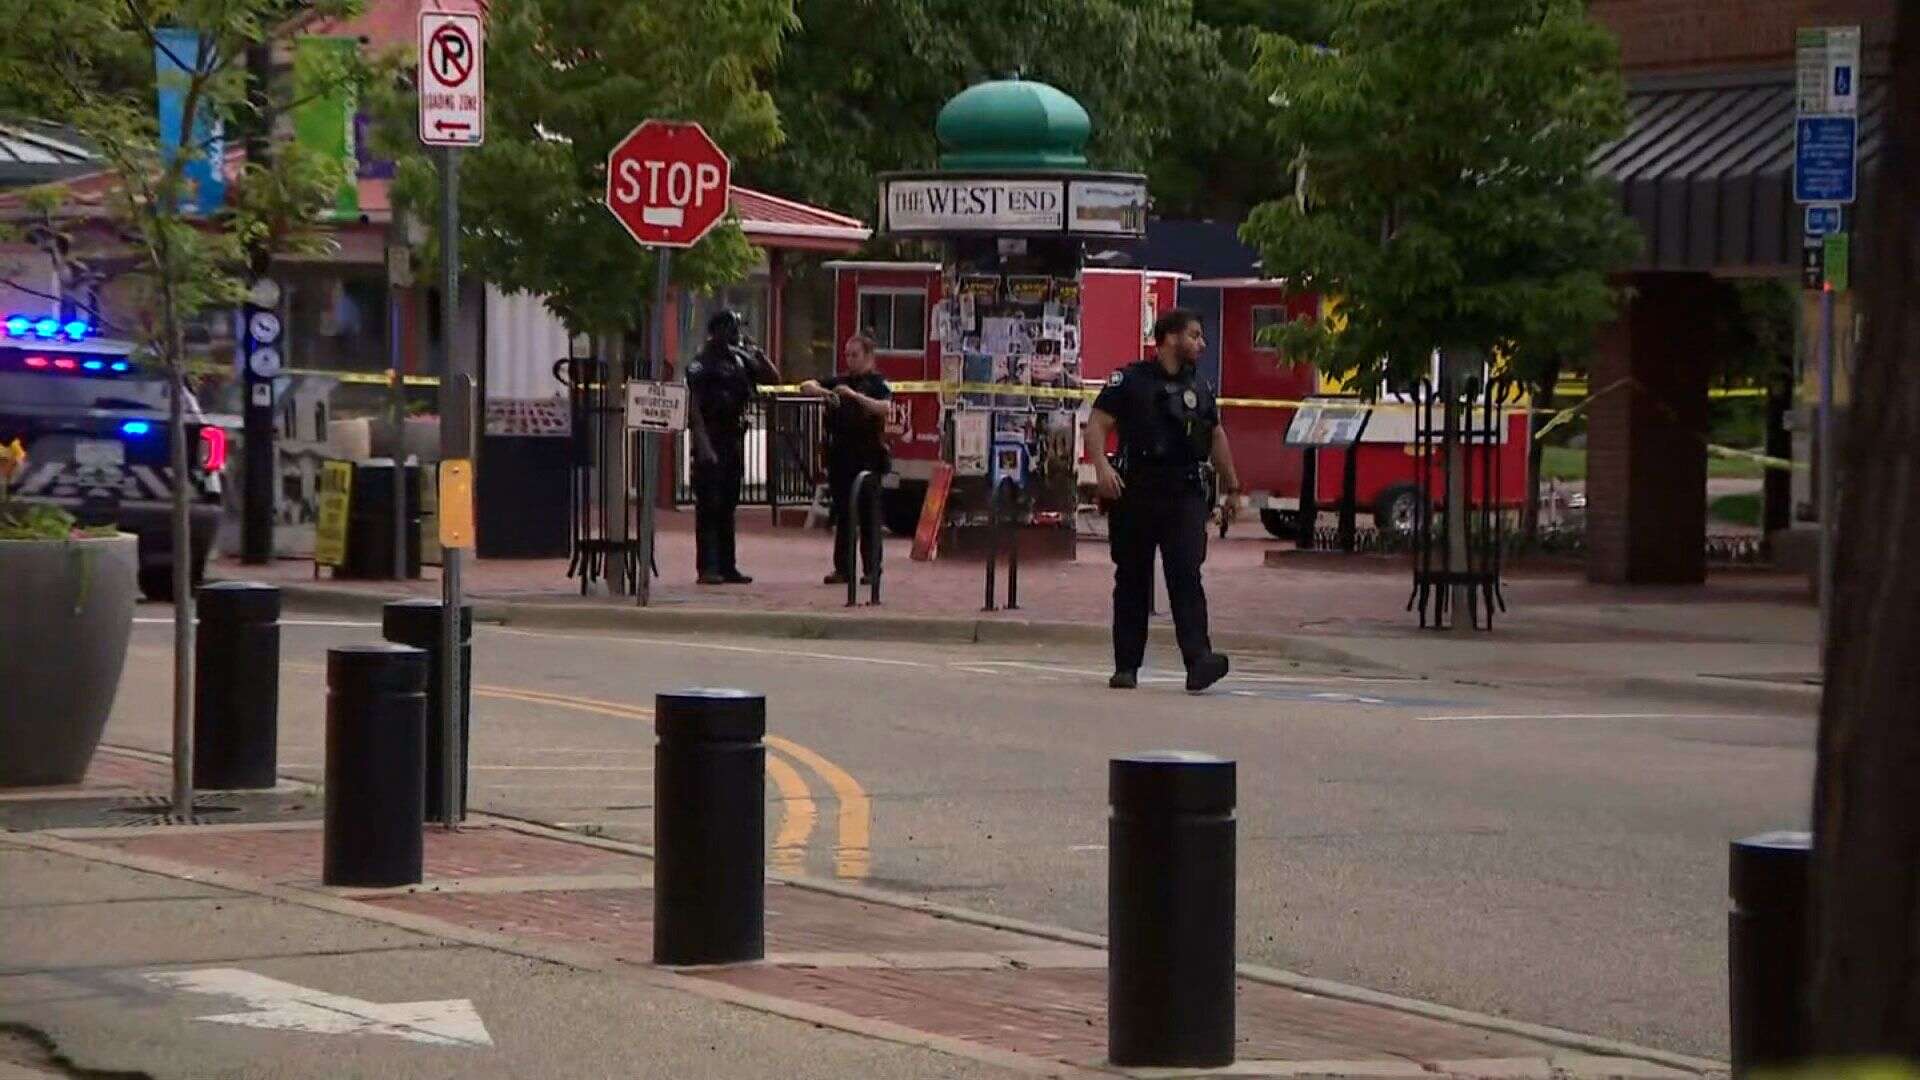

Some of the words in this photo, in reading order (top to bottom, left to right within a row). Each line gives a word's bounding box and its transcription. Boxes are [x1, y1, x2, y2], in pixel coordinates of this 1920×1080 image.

[424, 94, 455, 111] LOADING
[458, 95, 477, 111] ZONE
[616, 158, 721, 207] STOP
[895, 190, 924, 212] THE
[926, 186, 1004, 215] WEST
[1007, 189, 1057, 211] END
